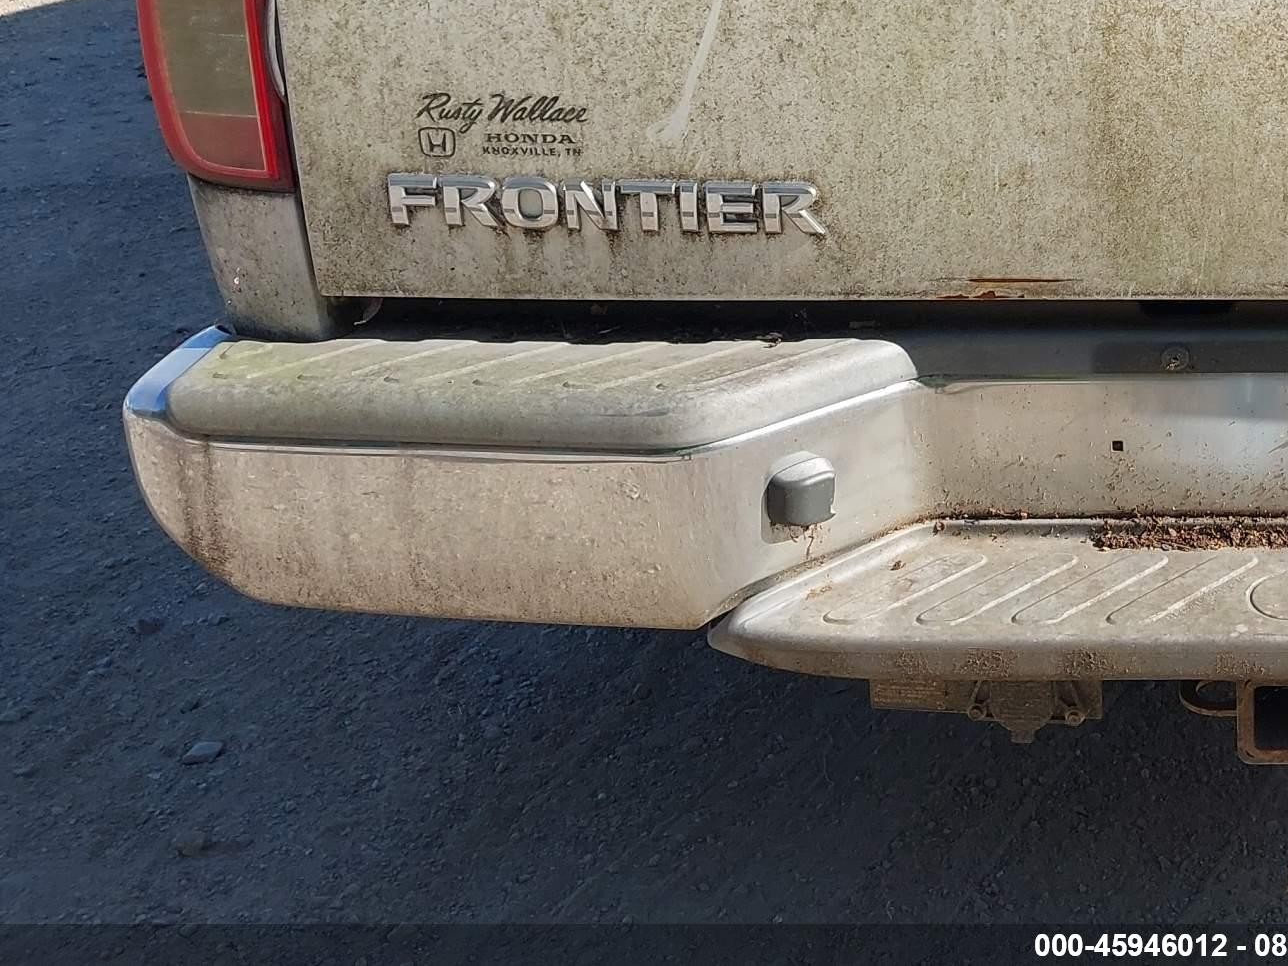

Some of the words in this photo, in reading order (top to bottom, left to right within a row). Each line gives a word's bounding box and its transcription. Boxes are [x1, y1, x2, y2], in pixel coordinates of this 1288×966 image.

[415, 92, 483, 134] Rusty
[487, 93, 588, 123] Wallace
[482, 146, 561, 158] KNOXVILLE,
[566, 147, 582, 157] TN
[486, 133, 575, 144] HONDA
[387, 173, 827, 236] FRONTIER
